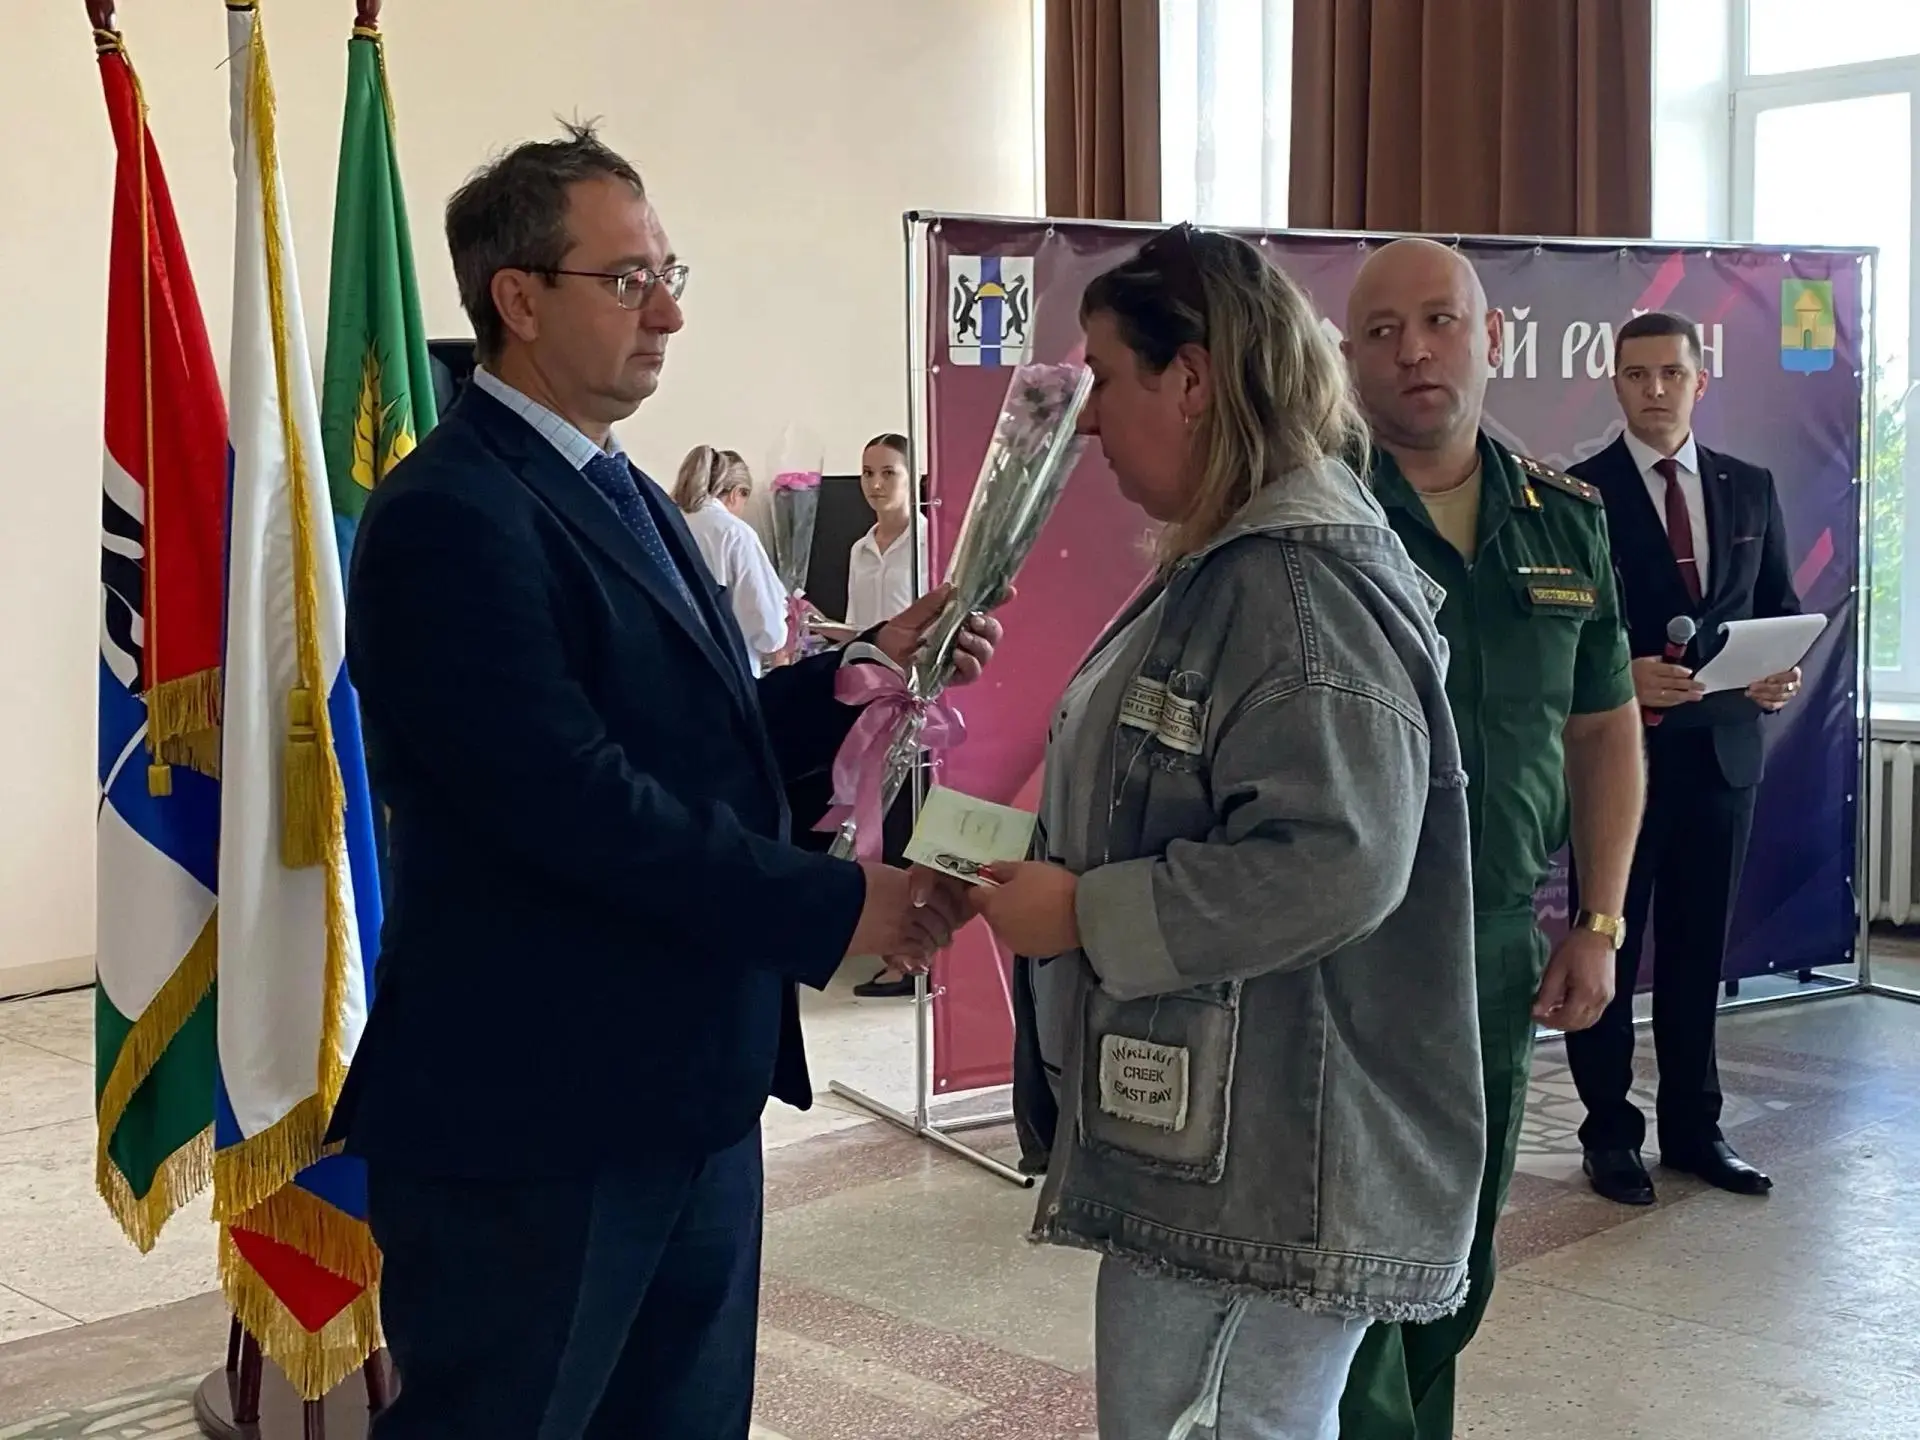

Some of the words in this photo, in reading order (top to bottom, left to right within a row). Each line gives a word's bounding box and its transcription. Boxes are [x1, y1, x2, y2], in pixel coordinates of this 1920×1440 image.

[1562, 308, 1723, 379] РАН
[1123, 1066, 1164, 1083] CREEK
[1114, 1080, 1146, 1102] EAST
[1149, 1087, 1172, 1104] BAY
